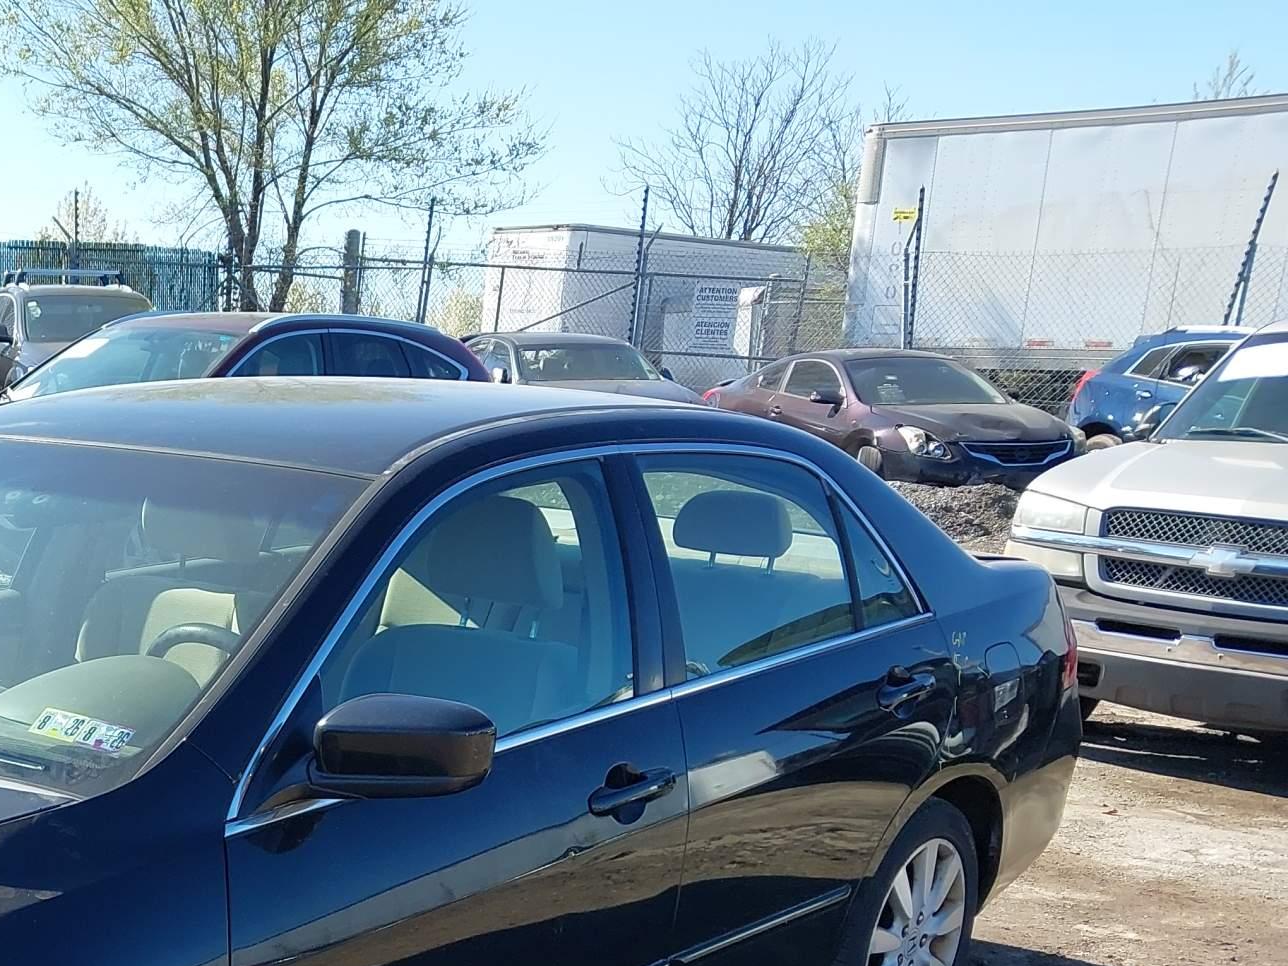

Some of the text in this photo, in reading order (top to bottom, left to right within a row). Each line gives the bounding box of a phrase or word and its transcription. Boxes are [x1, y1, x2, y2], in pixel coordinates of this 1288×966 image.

[698, 287, 738, 295] ATTENTION
[696, 294, 738, 302] CUSTOMERS
[695, 328, 729, 336] CLIENTES
[37, 715, 85, 736] 8 26
[82, 726, 98, 741] 8
